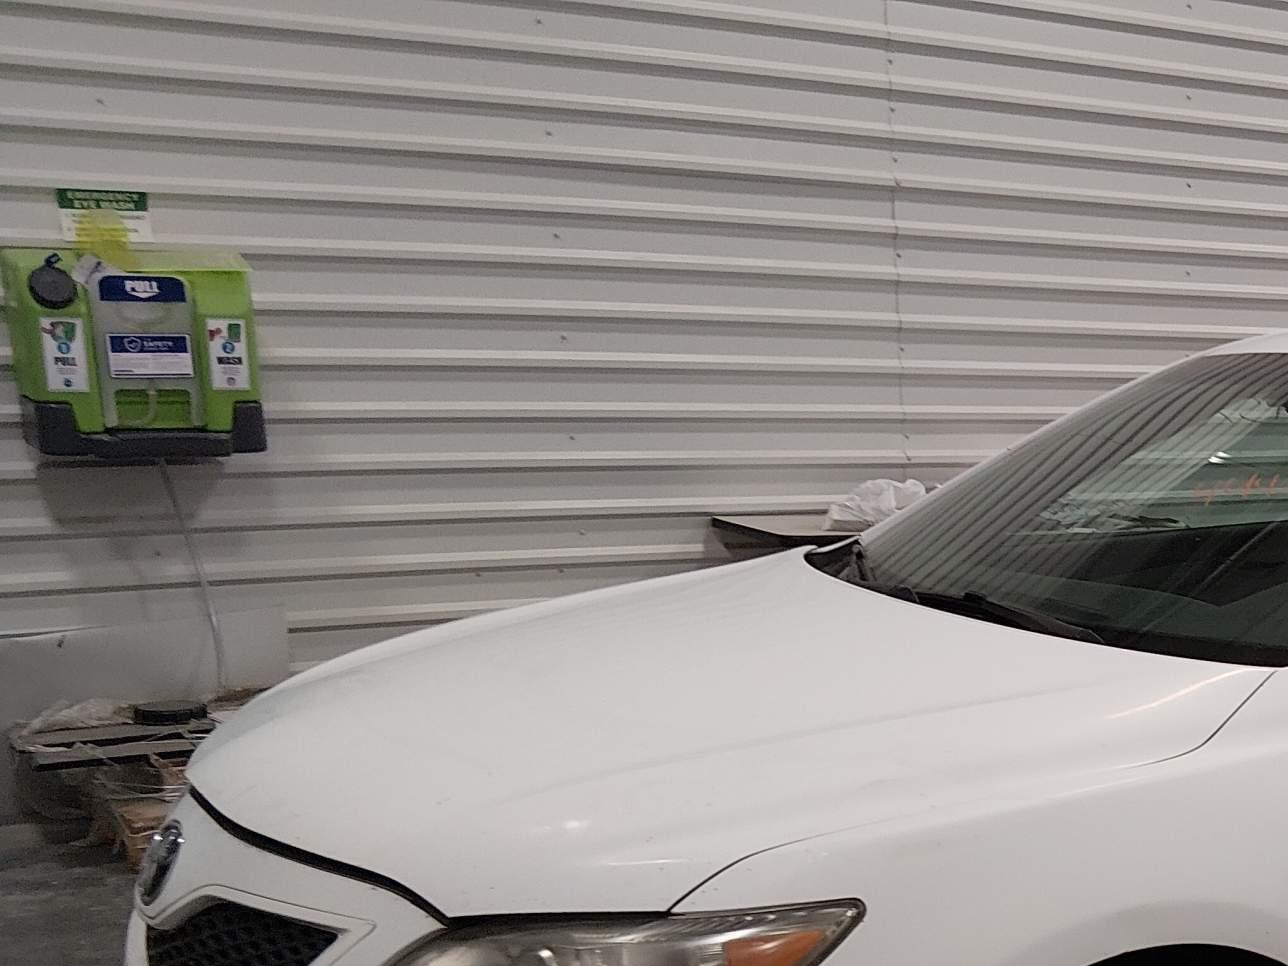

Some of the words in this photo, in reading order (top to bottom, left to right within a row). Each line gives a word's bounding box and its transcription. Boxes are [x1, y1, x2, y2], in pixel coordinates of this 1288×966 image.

[73, 200, 97, 209] EYE
[124, 280, 160, 293] PULL
[54, 356, 78, 366] PULL
